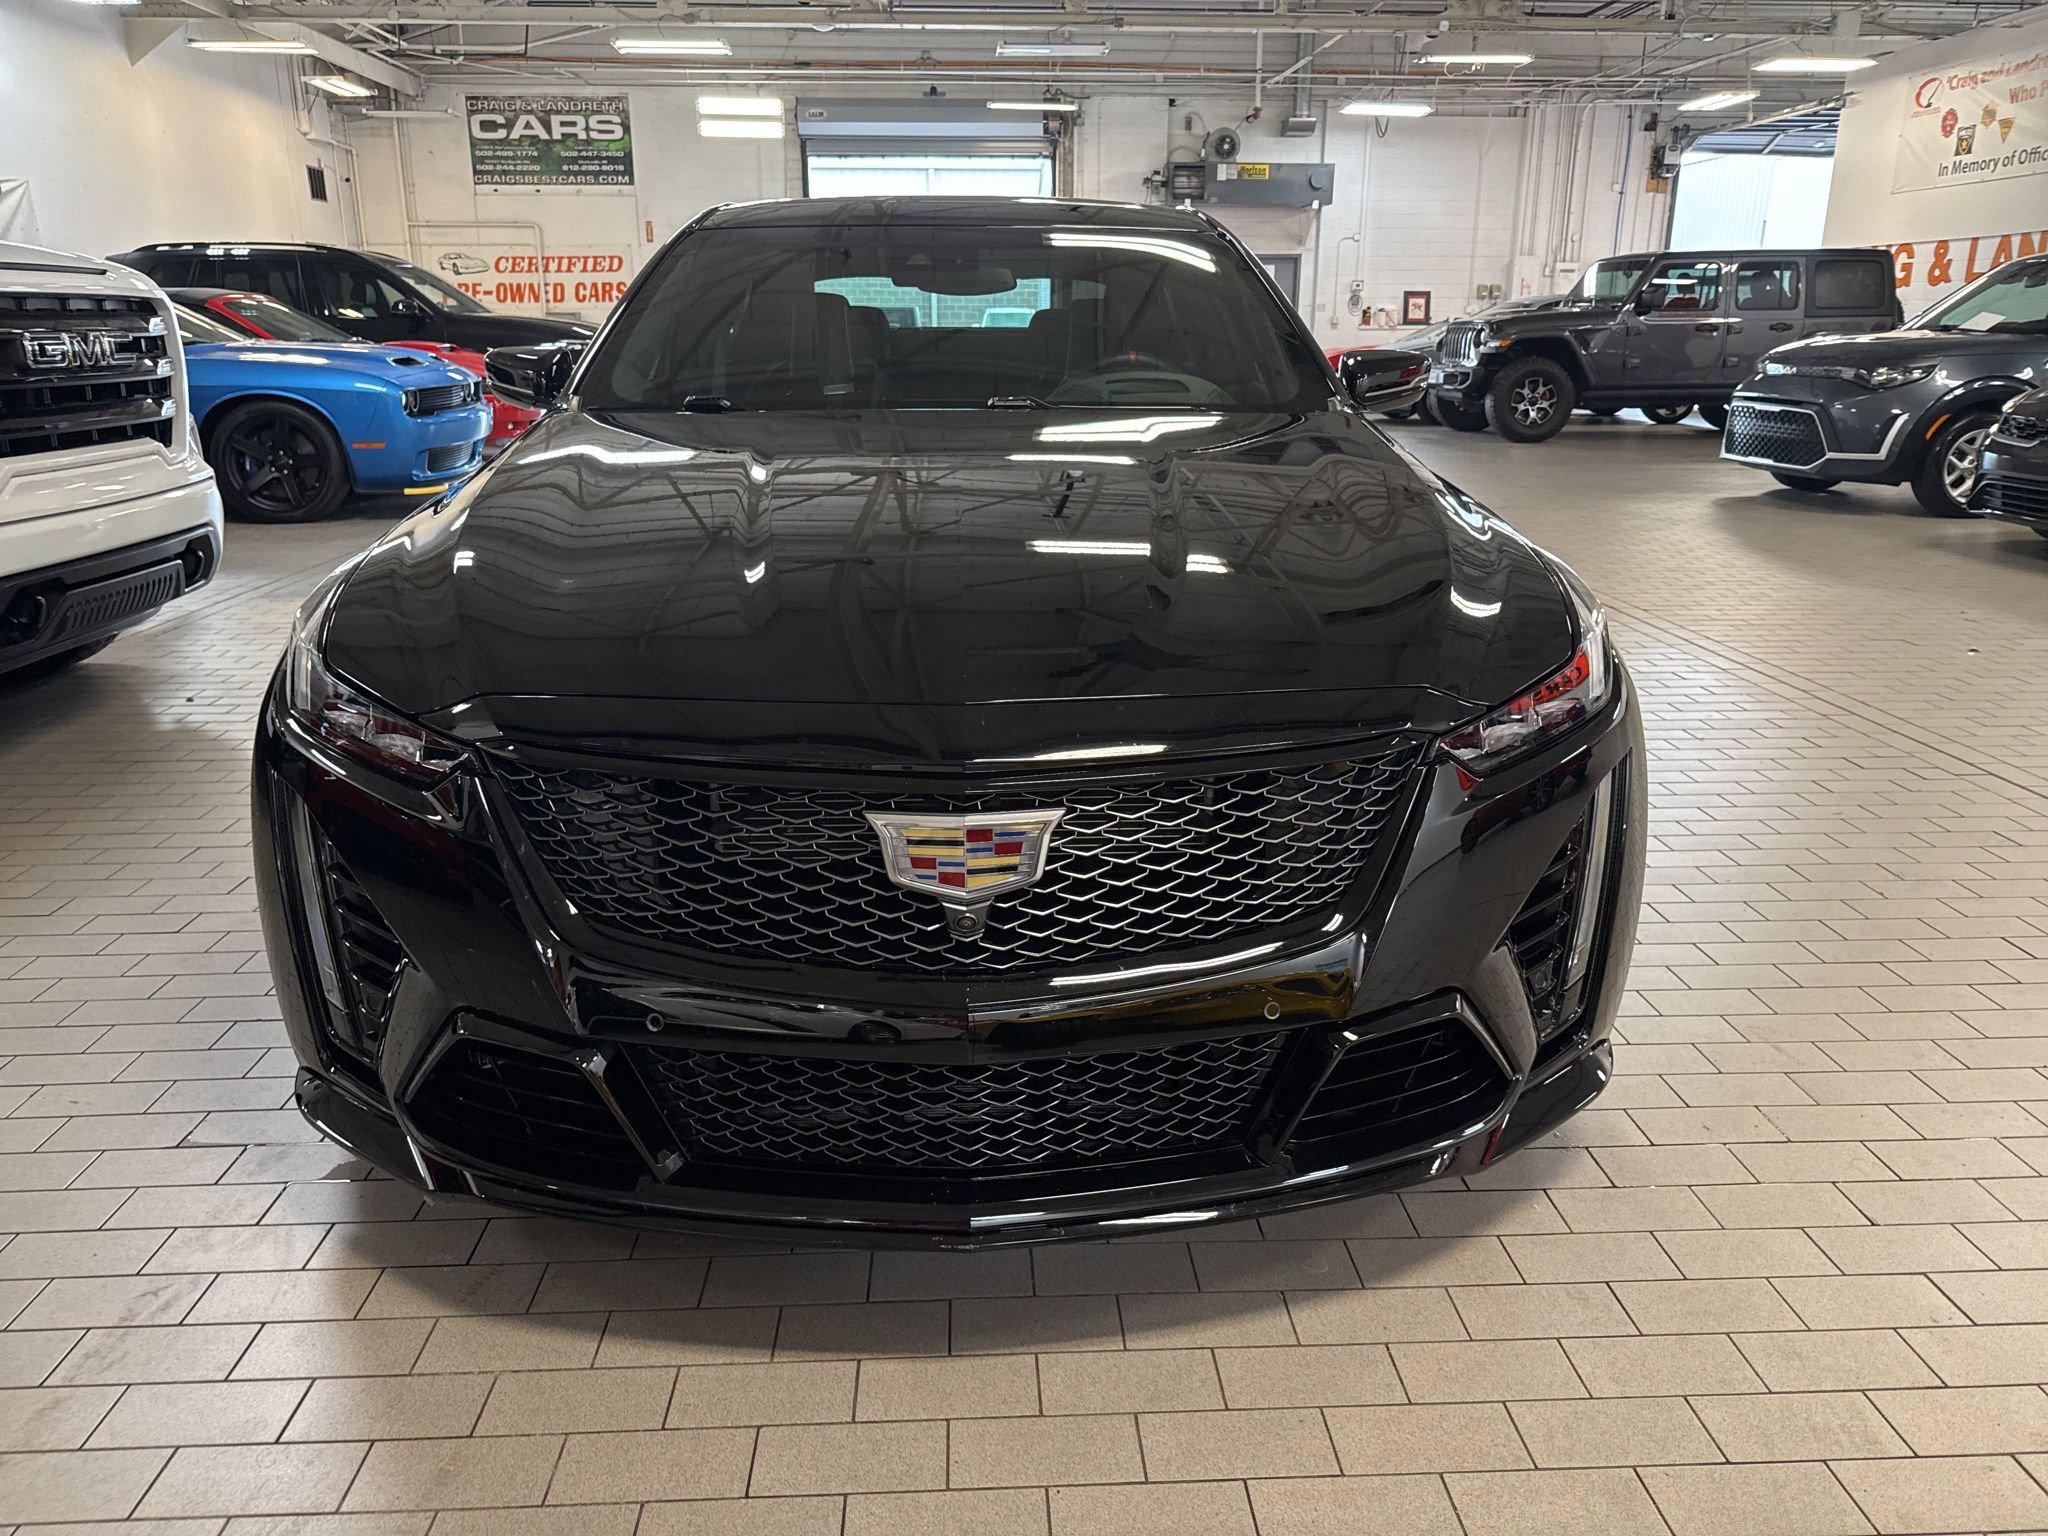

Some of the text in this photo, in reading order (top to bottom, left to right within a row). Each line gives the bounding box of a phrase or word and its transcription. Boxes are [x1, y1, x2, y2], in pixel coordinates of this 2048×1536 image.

[467, 100, 624, 112] CRAIG & LANDRETH
[2009, 84, 2037, 104] Who
[470, 114, 624, 141] CARS
[1938, 162, 1949, 177] In
[1951, 156, 2001, 175] Memory
[2002, 149, 2018, 167] of
[494, 255, 624, 274] CERTIFIED
[1927, 240, 1952, 287] &
[574, 281, 628, 304] CARS
[22, 331, 137, 369] GMC
